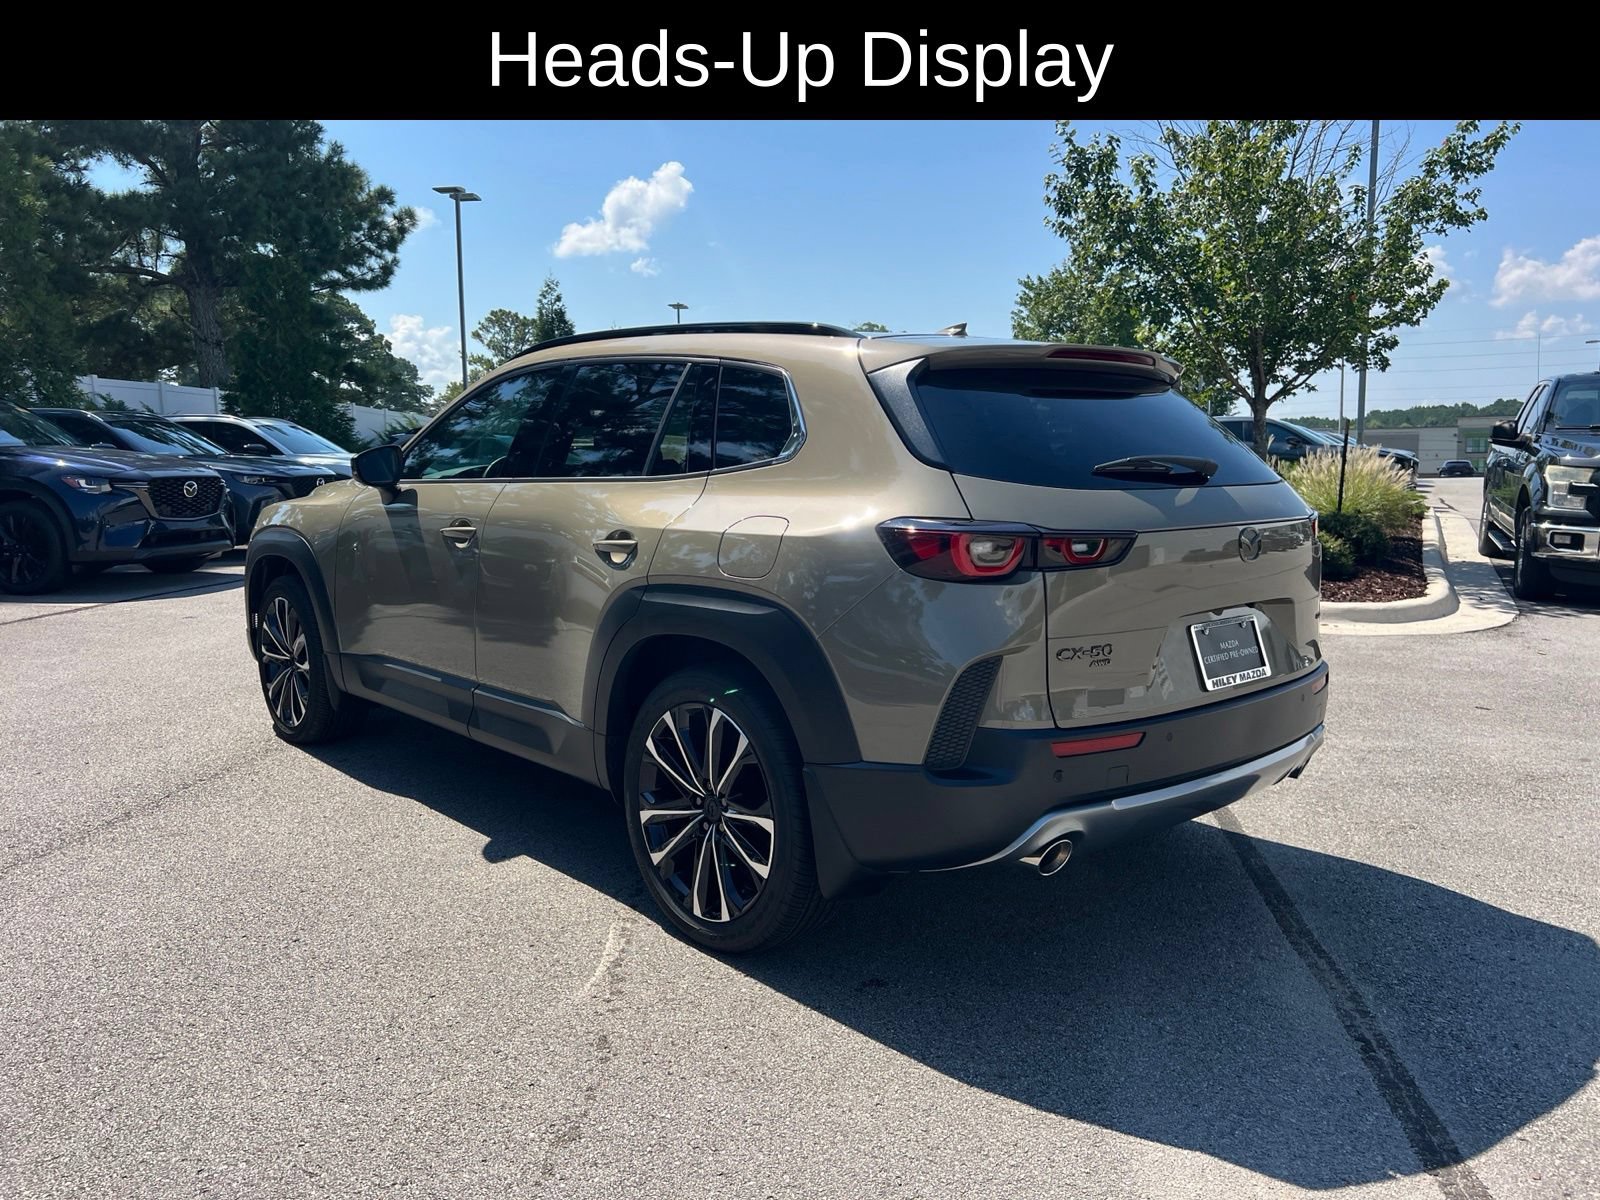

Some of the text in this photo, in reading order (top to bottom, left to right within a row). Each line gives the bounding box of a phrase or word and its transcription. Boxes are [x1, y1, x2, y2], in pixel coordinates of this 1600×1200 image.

[1056, 643, 1112, 661] CX-50
[1220, 640, 1240, 650] MAZDA
[1204, 646, 1259, 665] CERTIFIED PRE-OWNED
[1211, 668, 1267, 689] HILEY MAZDA
